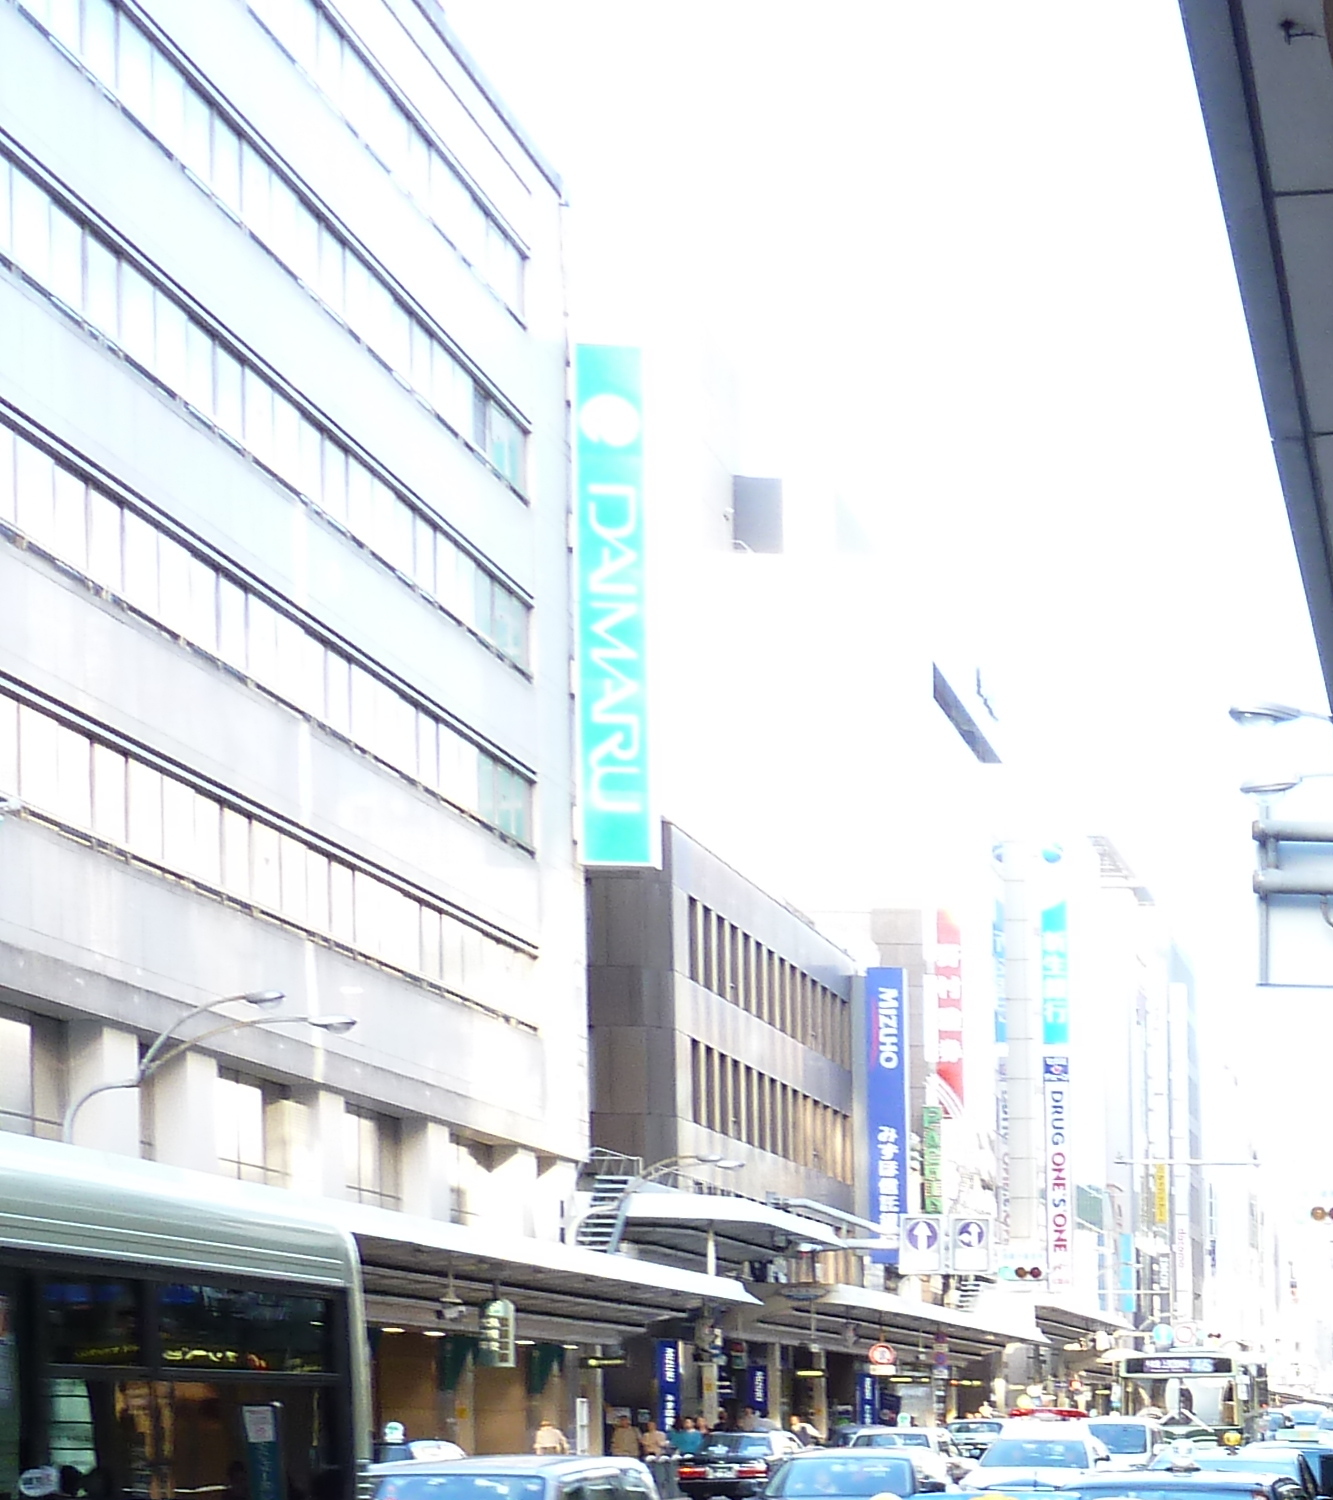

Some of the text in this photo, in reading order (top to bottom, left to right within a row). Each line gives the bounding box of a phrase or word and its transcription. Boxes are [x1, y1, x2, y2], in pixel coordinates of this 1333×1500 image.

[587, 483, 645, 814] DAIMARU
[878, 987, 899, 1070] MIZUHO
[1050, 1091, 1065, 1145] DRUG
